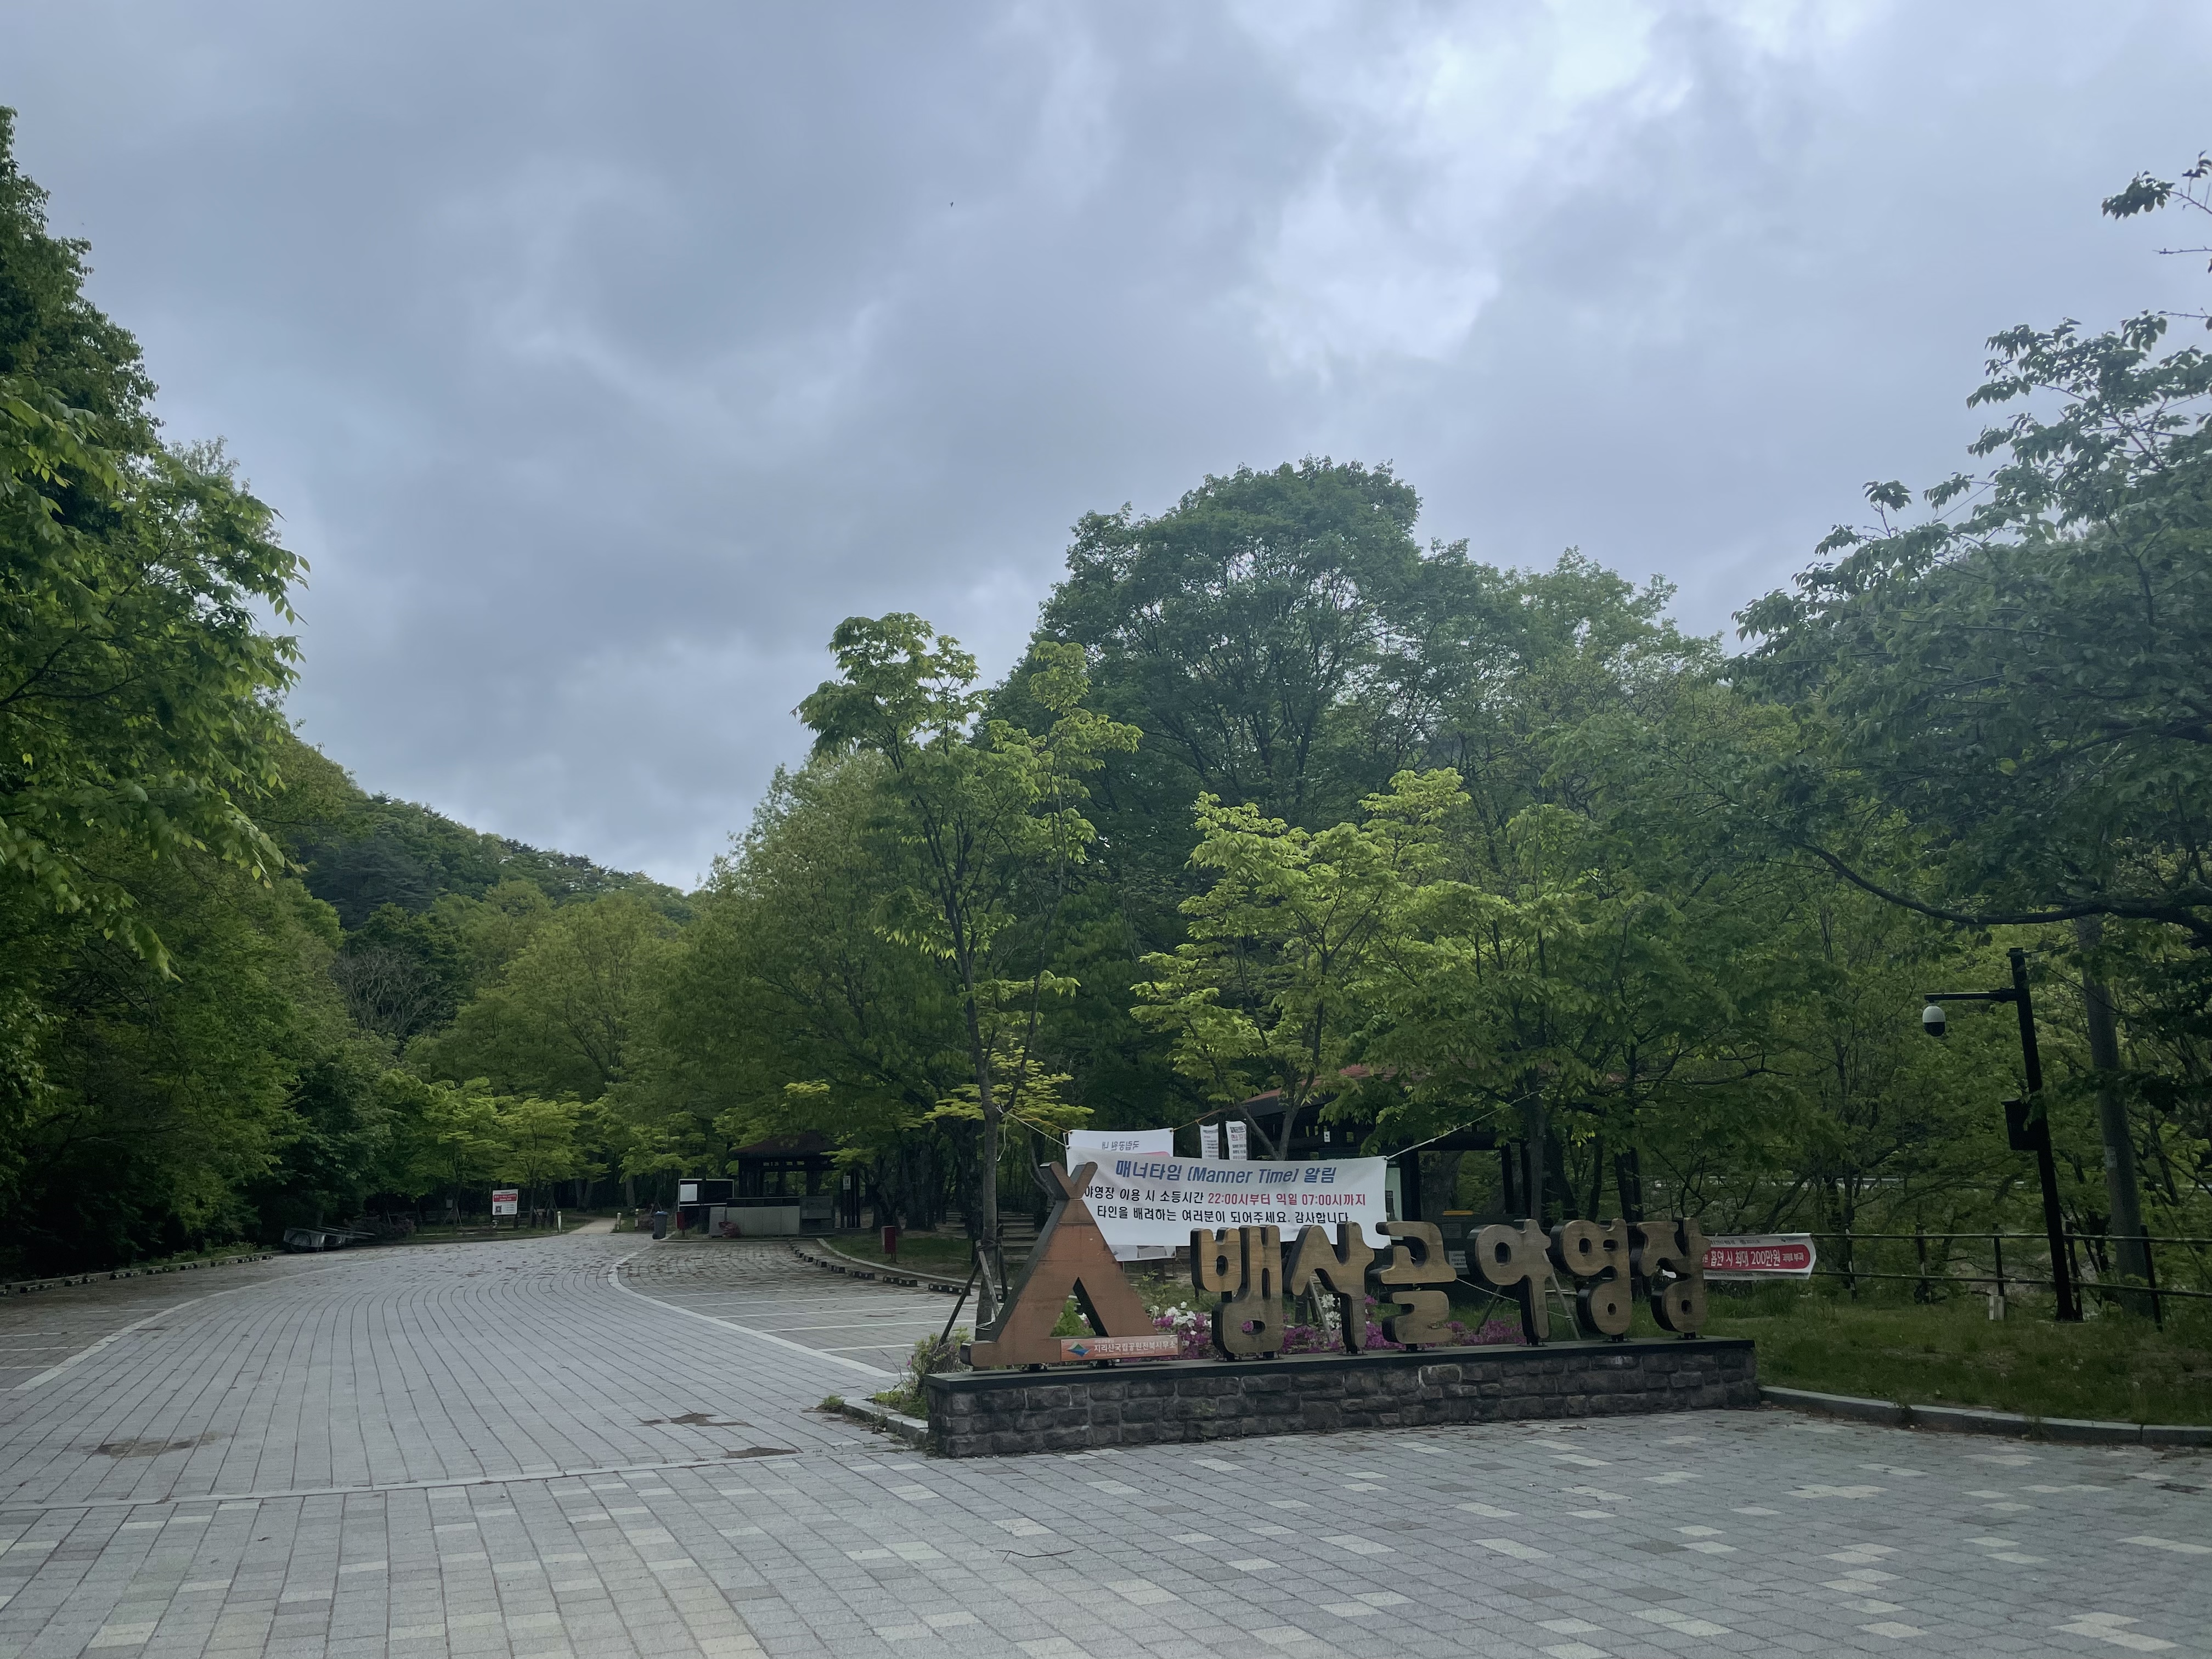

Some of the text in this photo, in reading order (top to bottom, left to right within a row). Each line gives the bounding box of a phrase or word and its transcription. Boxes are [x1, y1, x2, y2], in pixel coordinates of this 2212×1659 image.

[1115, 1160, 1182, 1181] 매너타임
[1304, 1167, 1337, 1183] 알림
[1085, 1186, 1365, 1206] 야영장 이용 시 소등시간 22:00시부터 익일 07:00시까지
[1097, 1205, 1128, 1219] 타인을
[1133, 1207, 1177, 1221] 배려하는
[1182, 1209, 1226, 1223] 여러분이
[1231, 1211, 1290, 1224] 되어주세요.
[1711, 1250, 1724, 1267] 흡연
[1726, 1250, 1733, 1267] 시
[1735, 1250, 1749, 1267] 최대
[1750, 1249, 1780, 1267] 200만원
[1190, 1217, 1711, 1355] 뱀사골 야영장
[1094, 1340, 1176, 1353] 지리산국립공원전북사무소
